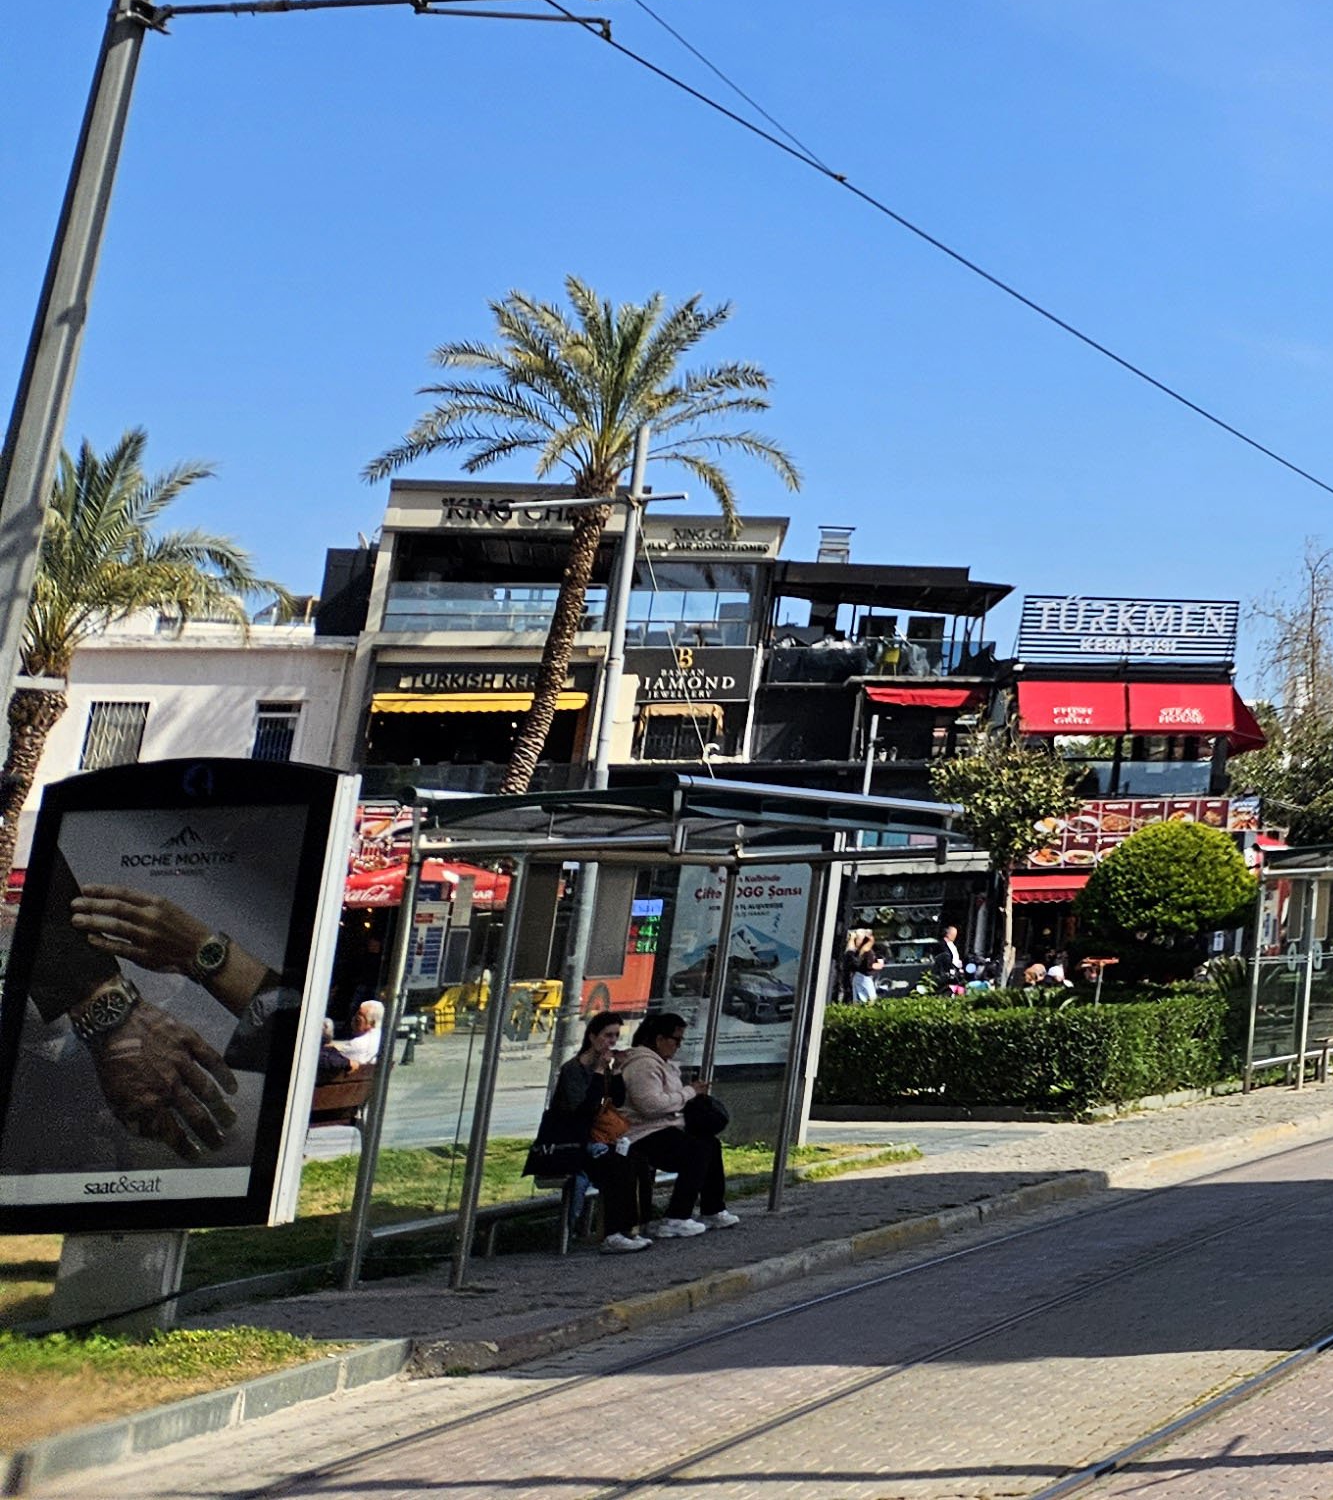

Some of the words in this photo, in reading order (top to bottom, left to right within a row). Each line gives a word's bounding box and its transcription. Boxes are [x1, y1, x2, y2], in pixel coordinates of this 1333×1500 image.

[1035, 594, 1232, 636] TÜRKMEN
[408, 673, 494, 689] TURKISH
[644, 675, 736, 690] IAMOND
[120, 855, 171, 867] ROCHE
[694, 887, 722, 903] Çifte
[83, 1175, 162, 1194] saat&saat
